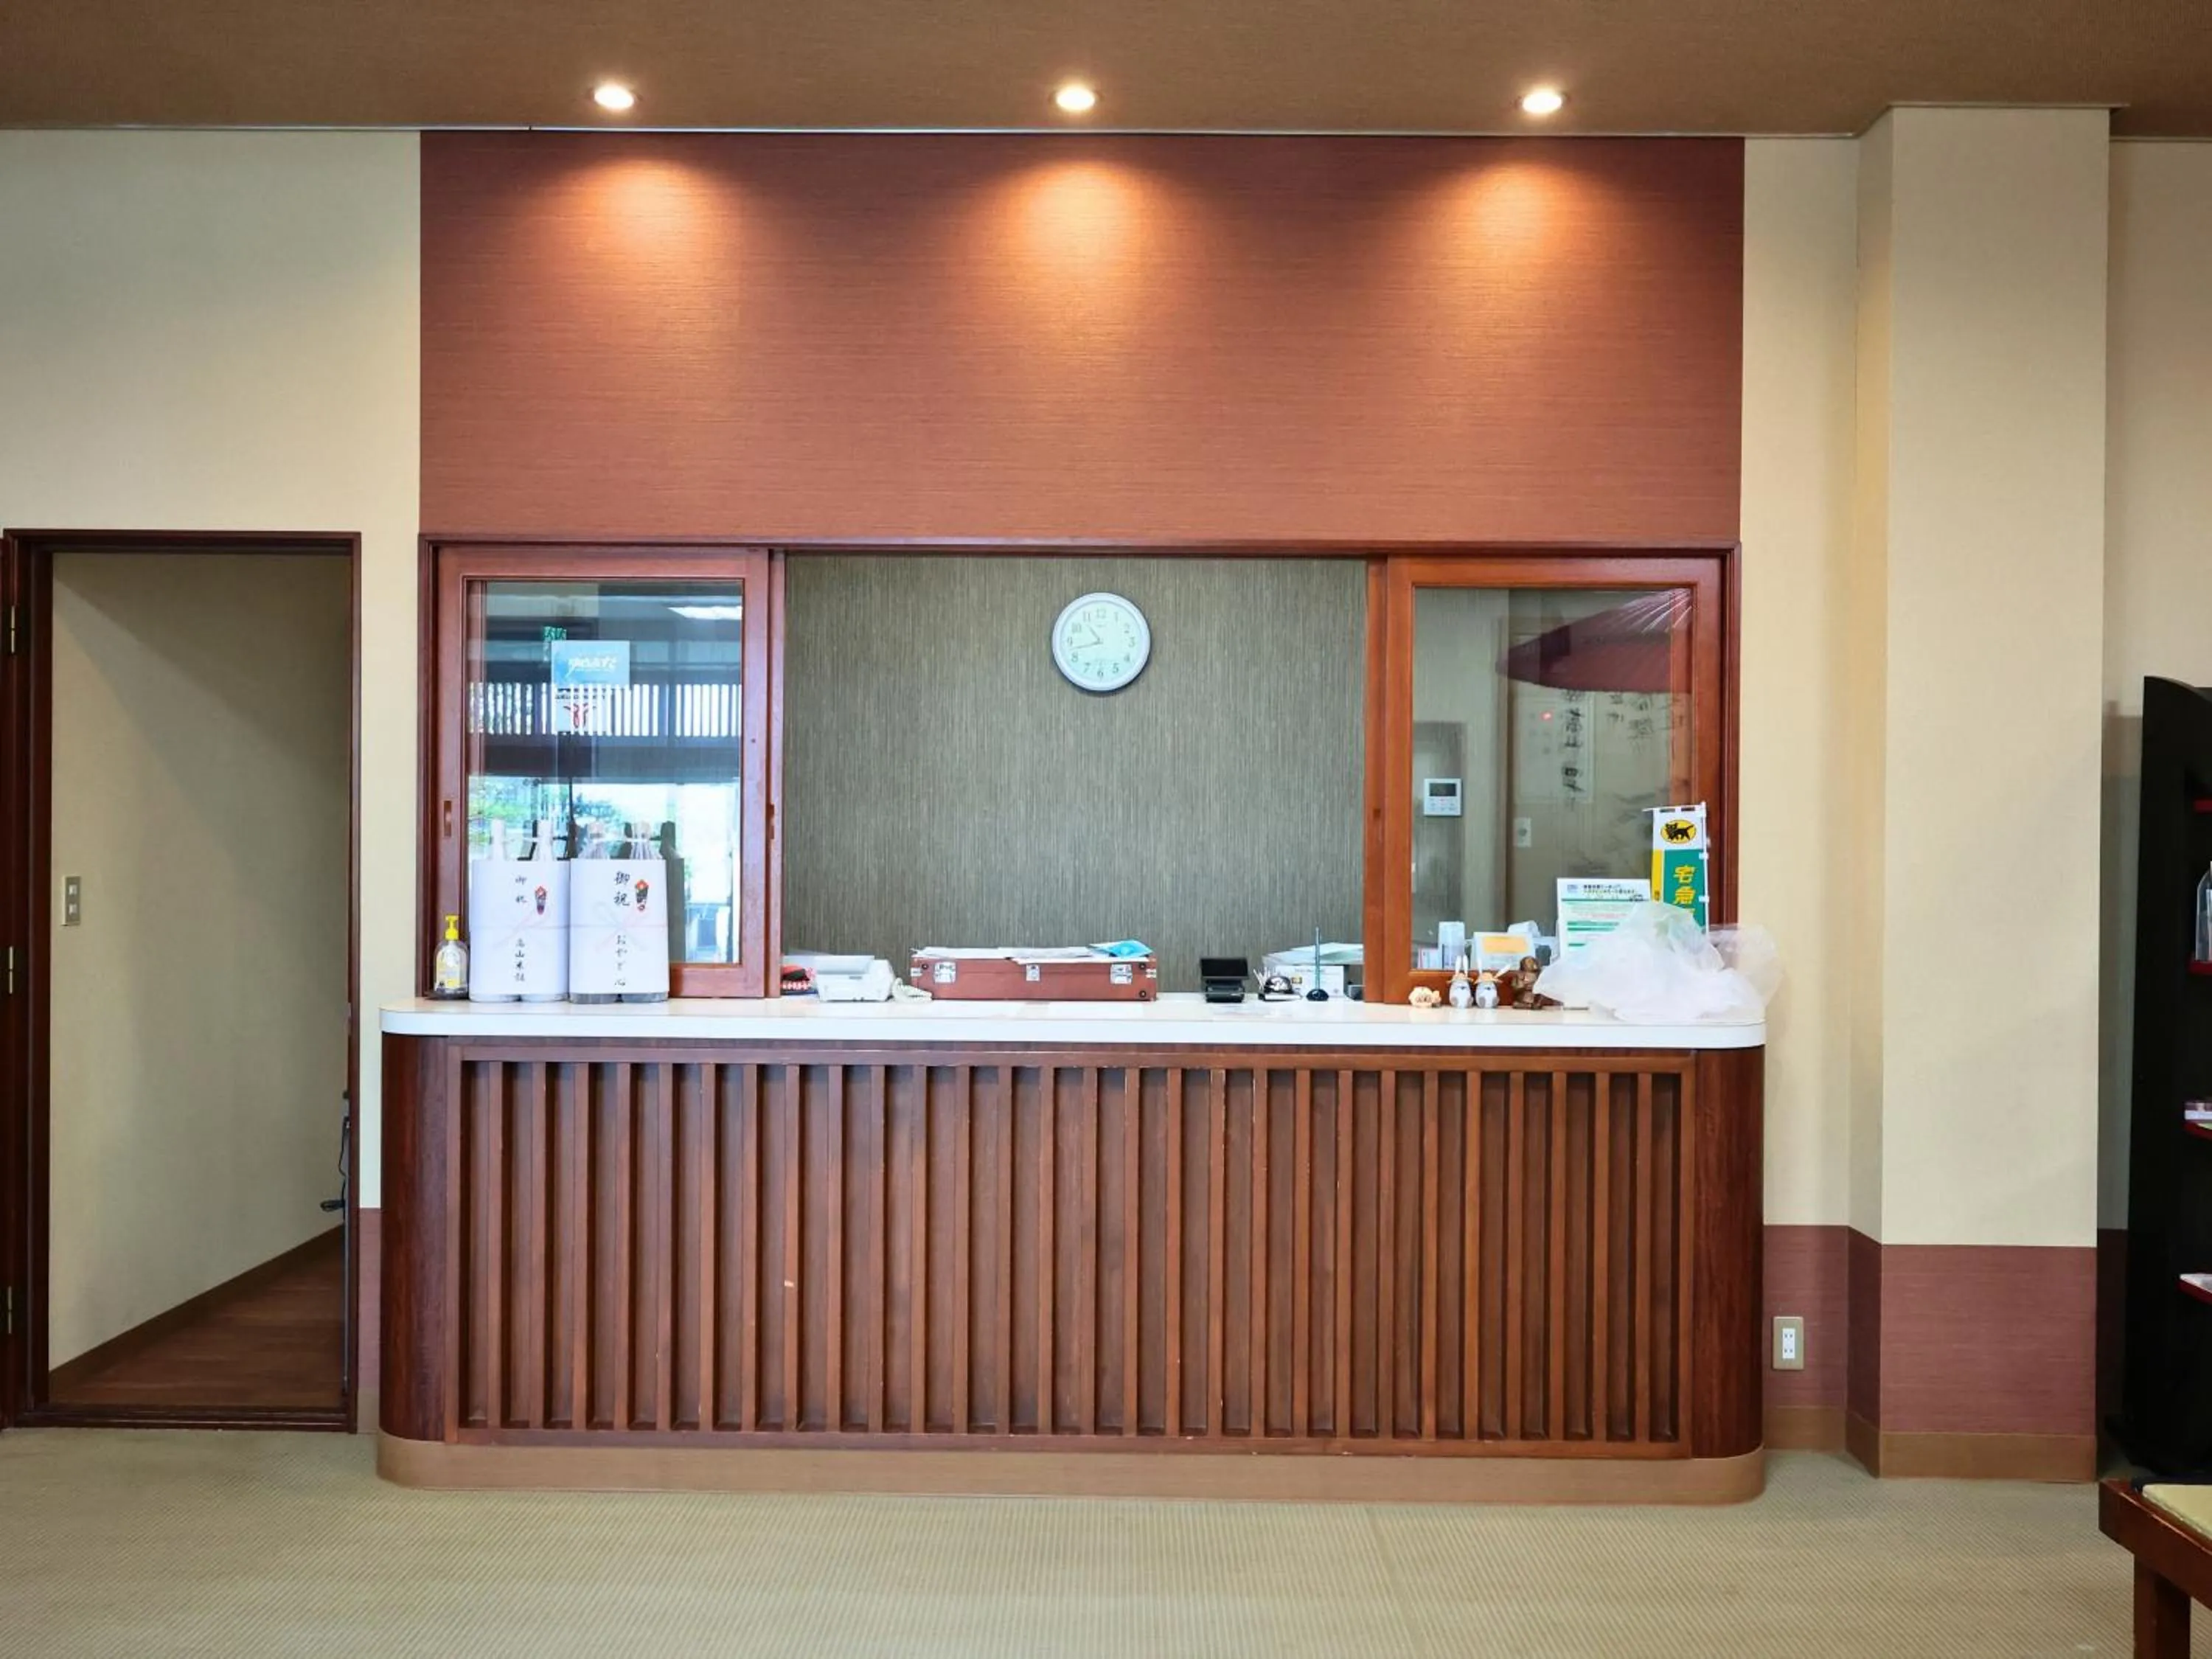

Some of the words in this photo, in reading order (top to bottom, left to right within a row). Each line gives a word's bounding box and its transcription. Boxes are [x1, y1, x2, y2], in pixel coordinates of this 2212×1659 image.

[1082, 611, 1091, 622] 11
[1128, 636, 1135, 647] 3
[1071, 652, 1079, 663] 8
[1083, 662, 1091, 673] 7
[1112, 662, 1119, 674] 5
[1673, 865, 1696, 914] 宅急
